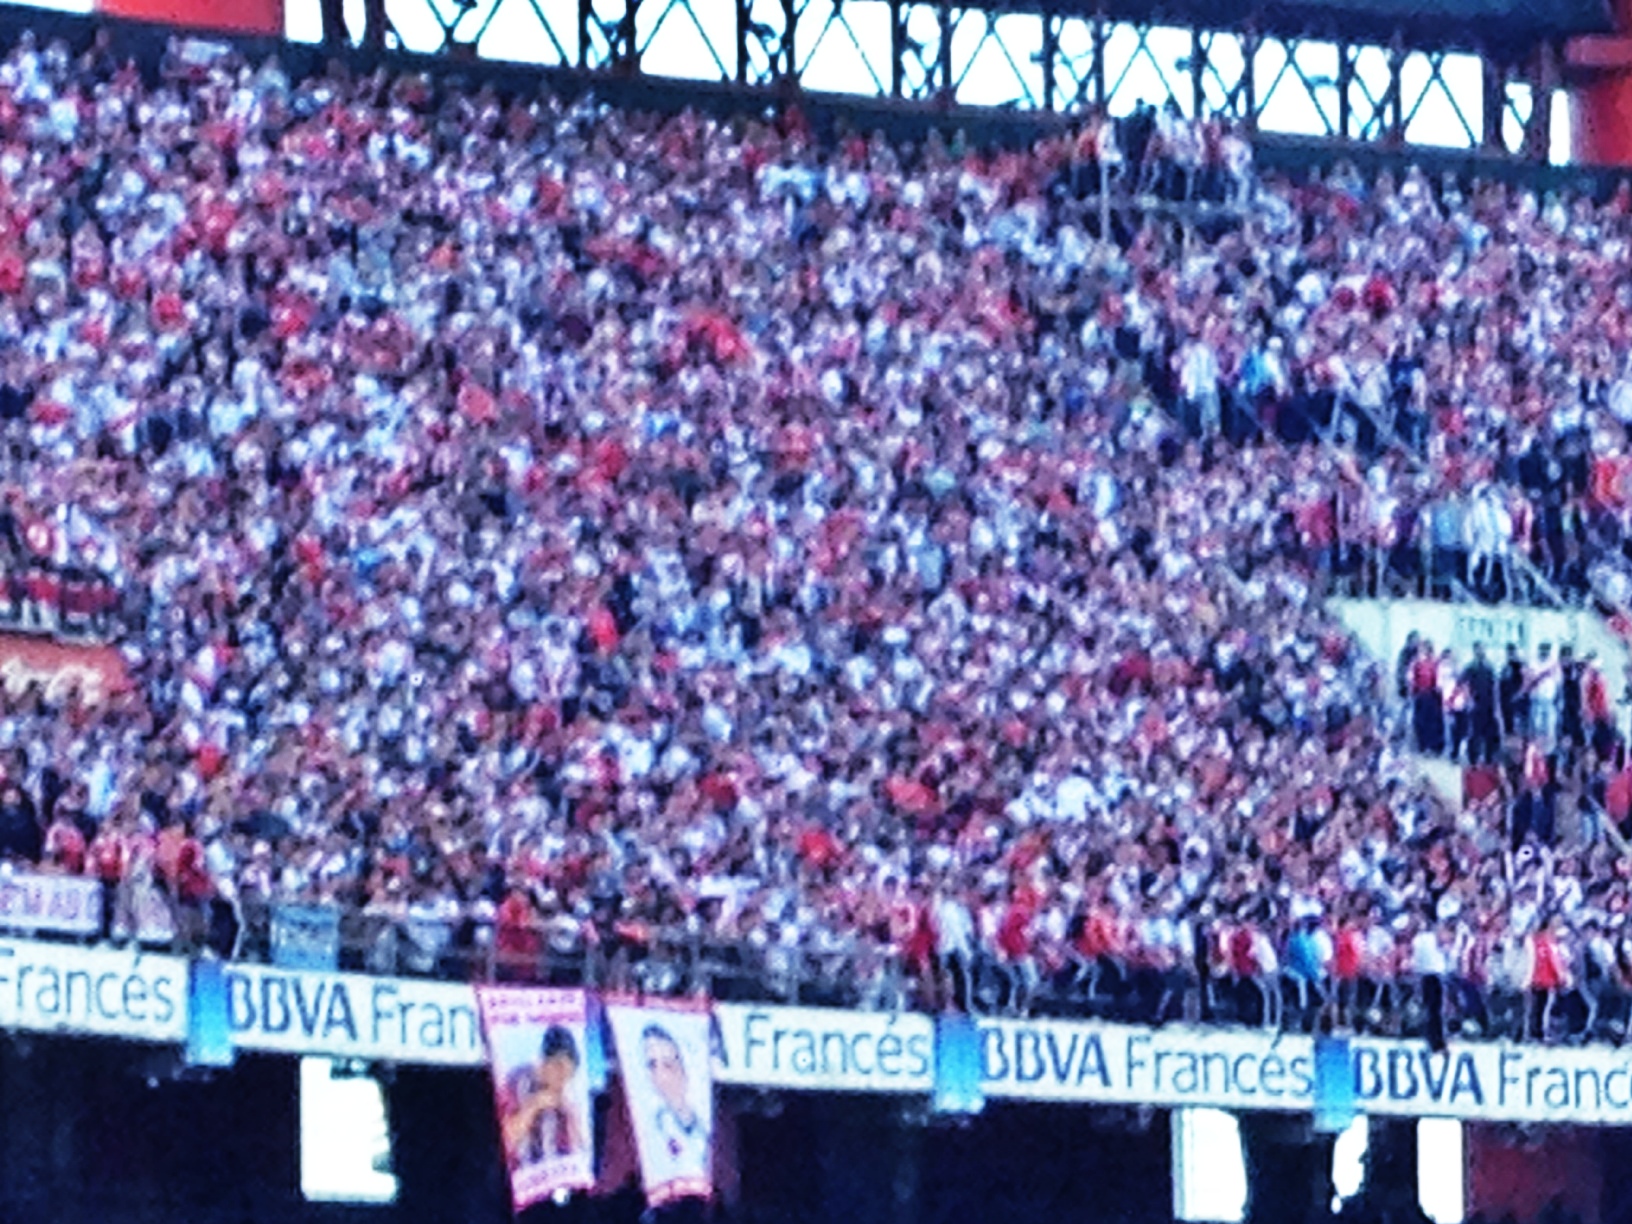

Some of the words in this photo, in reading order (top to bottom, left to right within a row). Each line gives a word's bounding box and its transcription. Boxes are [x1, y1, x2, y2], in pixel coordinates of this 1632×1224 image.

[228, 968, 357, 1042] BBVA
[372, 977, 476, 1051] Fran
[744, 1008, 930, 1078] Francés
[981, 1025, 1112, 1087] BBVA
[1125, 1033, 1314, 1097] Francés
[1351, 1045, 1483, 1105] BBVA
